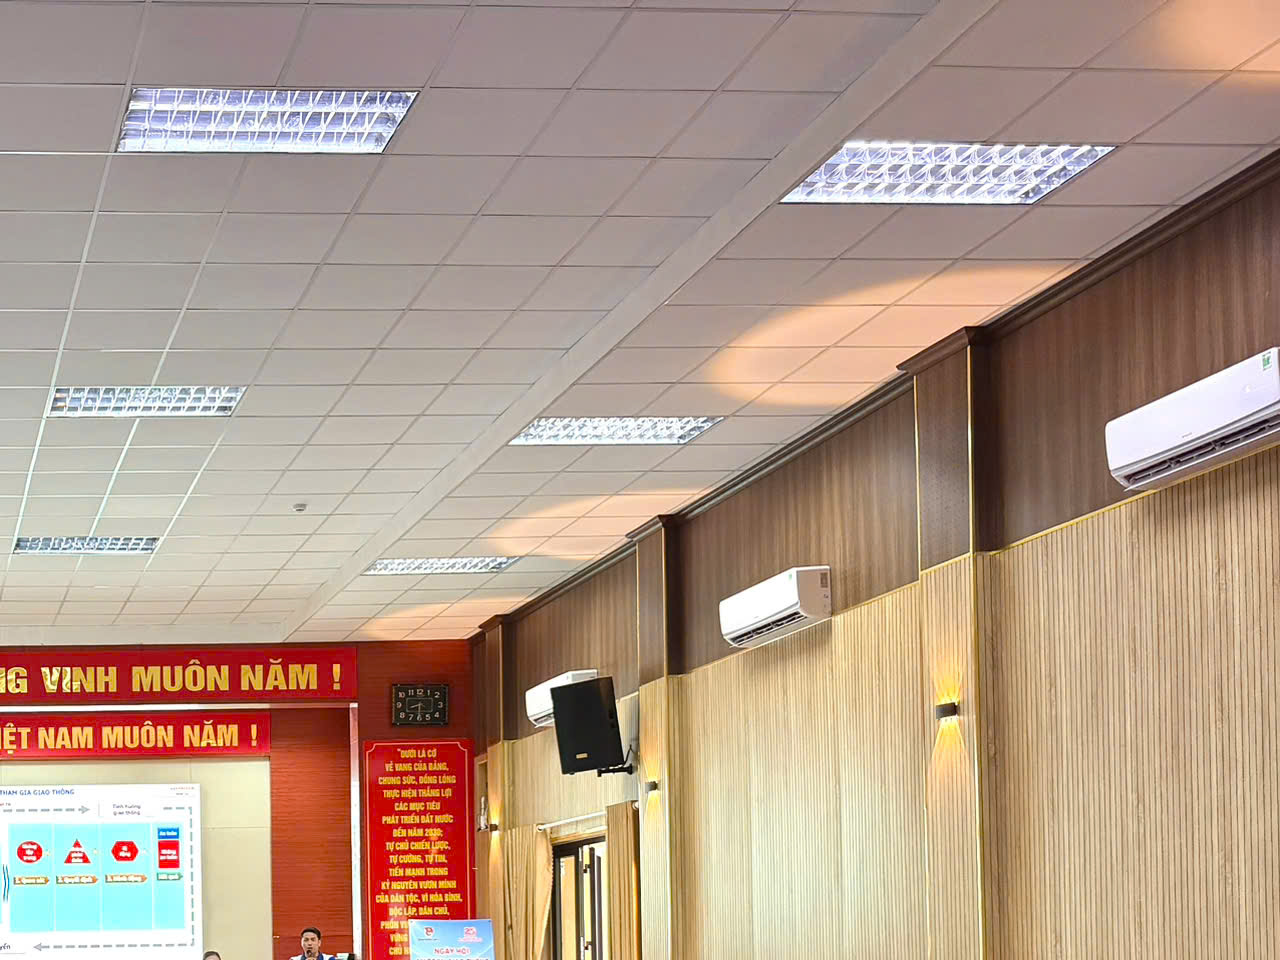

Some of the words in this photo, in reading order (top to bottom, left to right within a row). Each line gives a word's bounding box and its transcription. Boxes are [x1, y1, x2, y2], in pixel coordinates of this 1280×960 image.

[40, 666, 117, 693] VINH
[131, 659, 229, 692] MUÔN
[240, 657, 317, 691] NĂM
[332, 663, 341, 690] !
[38, 726, 94, 749] NAM
[101, 720, 174, 748] MUÔN
[183, 720, 238, 748] NĂM
[250, 724, 257, 747] !
